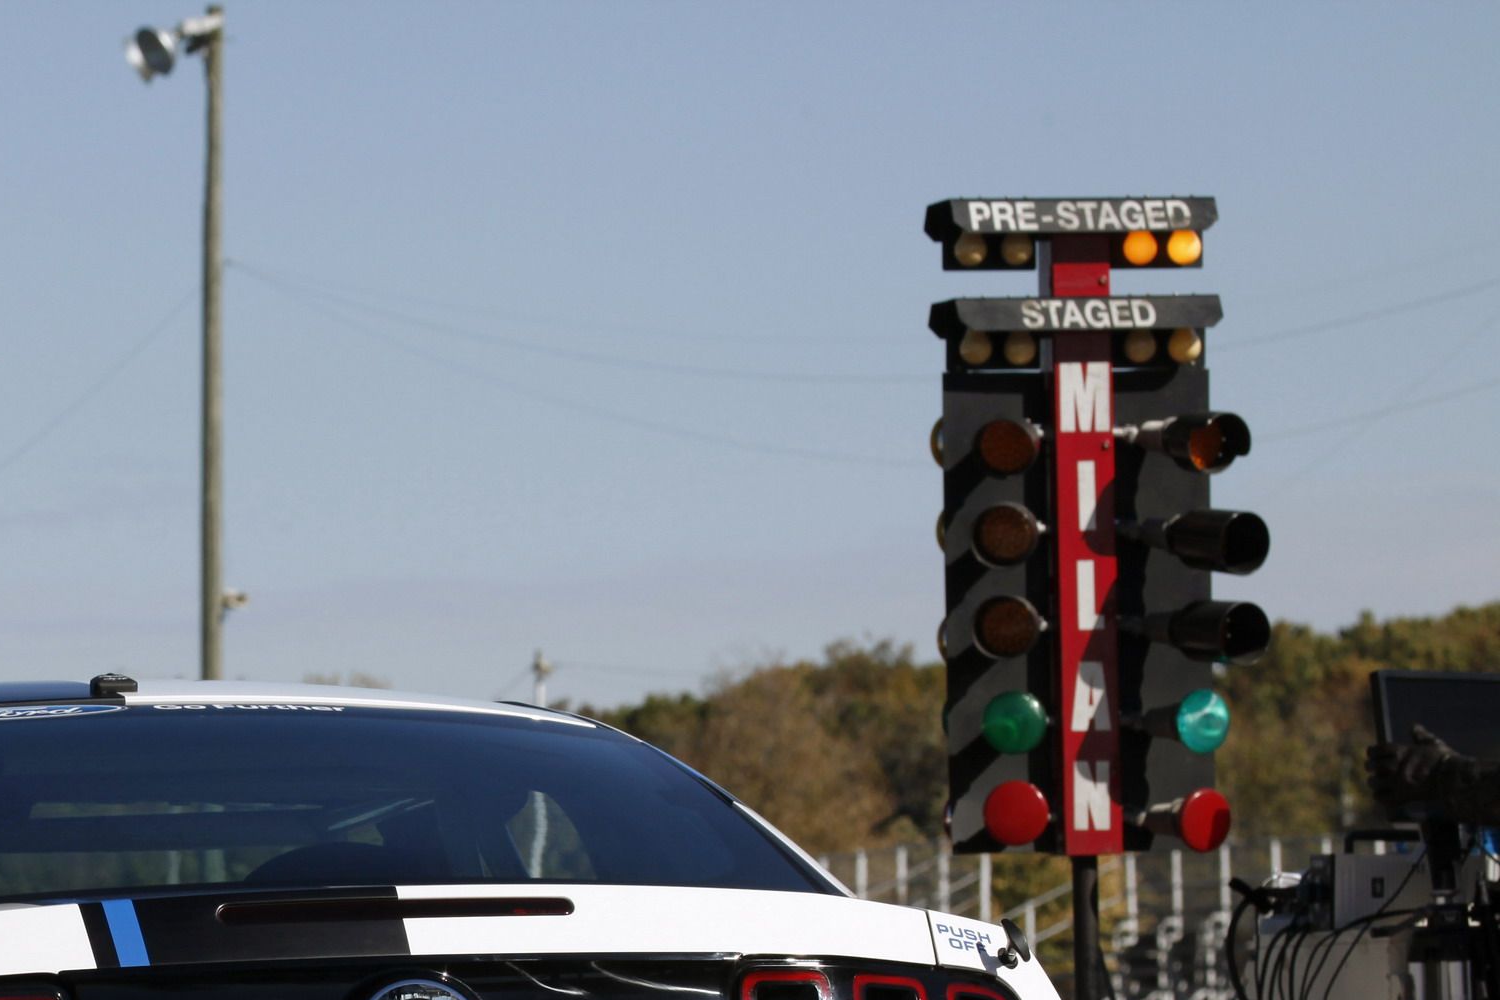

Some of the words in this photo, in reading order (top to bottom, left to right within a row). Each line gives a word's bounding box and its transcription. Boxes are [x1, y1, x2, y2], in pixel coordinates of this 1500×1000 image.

[968, 200, 1192, 231] PRE-STAGED
[1022, 300, 1157, 329] STAGED
[1057, 361, 1113, 831] MILAN
[212, 703, 345, 712] Further
[936, 923, 992, 945] PUSH
